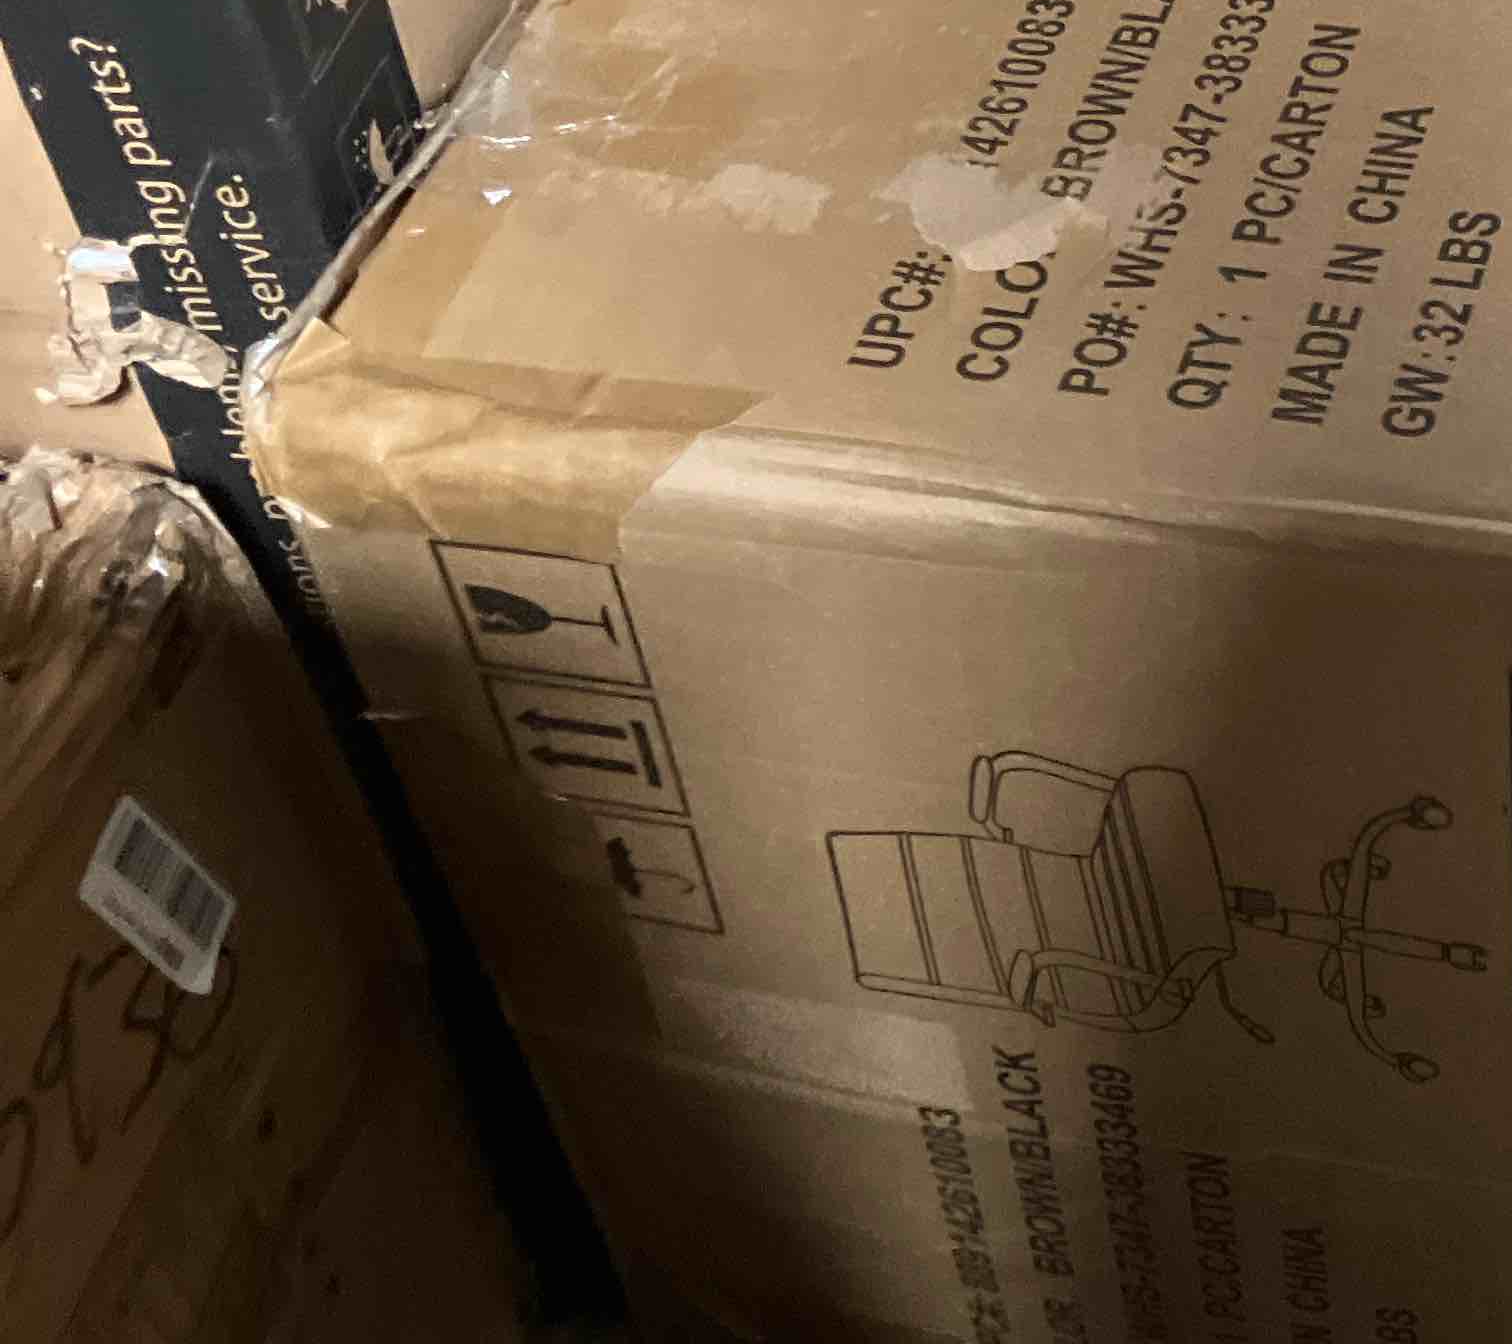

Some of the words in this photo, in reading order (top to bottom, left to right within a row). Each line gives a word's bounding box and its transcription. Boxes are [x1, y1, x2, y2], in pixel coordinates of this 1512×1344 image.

[68, 34, 173, 167] parts?
[1232, 23, 1362, 244] PC/CARTON
[1347, 104, 1435, 226] CHINA
[138, 179, 224, 333] missing
[214, 173, 292, 324] service.
[847, 251, 952, 369] UPC#:
[1216, 264, 1270, 284] 1
[1324, 244, 1386, 286] IN
[1429, 210, 1502, 290] LBS
[956, 252, 1057, 382] COLO
[1166, 311, 1253, 410] QTY:
[1272, 302, 1363, 426] MADE
[992, 1045, 1074, 1278] BROWN/BLACK
[1280, 1227, 1331, 1313] CHINA
